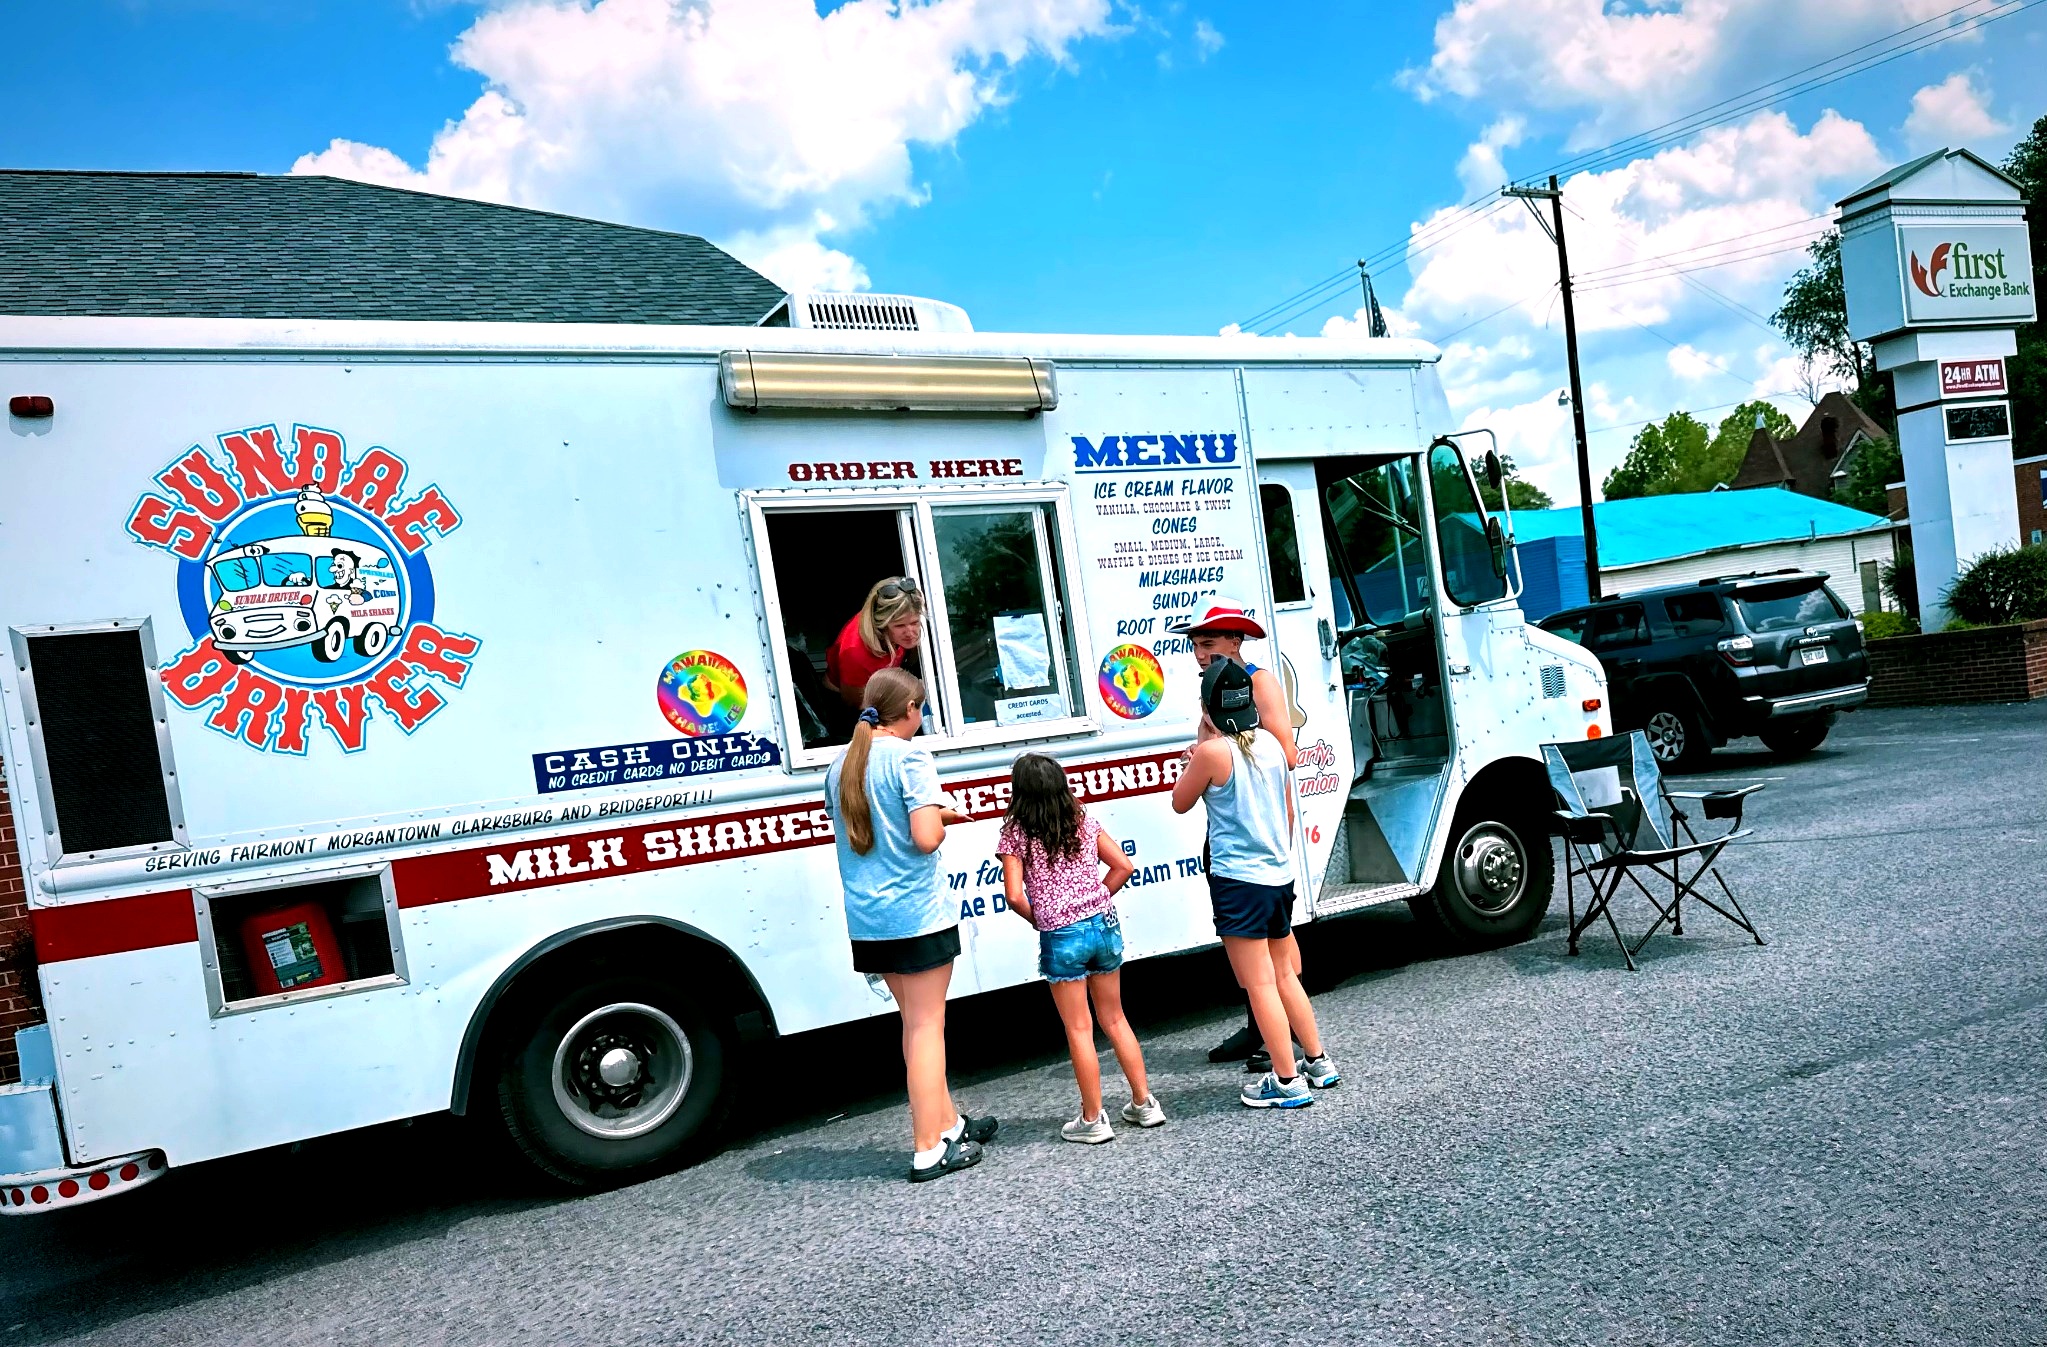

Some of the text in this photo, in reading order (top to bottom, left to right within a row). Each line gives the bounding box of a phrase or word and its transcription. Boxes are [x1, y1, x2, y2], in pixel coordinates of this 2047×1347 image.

[1952, 242, 2008, 280] first
[1949, 281, 2030, 300] Exchange Bank
[1975, 364, 1999, 382] ATM
[1071, 434, 1238, 468] MENU
[787, 458, 1024, 482] ORDER HERE
[127, 425, 461, 560] SUNDAE
[1094, 477, 1234, 499] ICE CREAM FLAVOR
[1095, 499, 1231, 516] VANILLA, CHOCOLATE & TWIST
[1152, 516, 1197, 535] CONES
[1114, 536, 1225, 554] SMALL, MEDIUM, LARGE,
[1097, 549, 1244, 570] WAFFLE & DISHES OF ICE CREAM
[1138, 566, 1224, 588] MILKSHAKES
[267, 591, 300, 603] DRIVER
[1153, 590, 1216, 610] SUNDA
[350, 609, 368, 618] MILK
[1117, 618, 1156, 637] ROOT
[159, 622, 481, 755] DRIVER
[1007, 698, 1049, 710] CREDIT CARDS
[1147, 690, 1161, 709] ICE
[723, 704, 742, 726] ICE
[545, 735, 762, 774] CASH ONLY
[548, 751, 771, 789] NO CREDIT CARDS NO DEBIT CARDS
[145, 789, 713, 872] SERVING FAIRMONT MORGANTOWN CLARKSBURG AND BRIDGEPORT!!!
[486, 837, 627, 886] MILK
[642, 807, 836, 863] SHAKES
